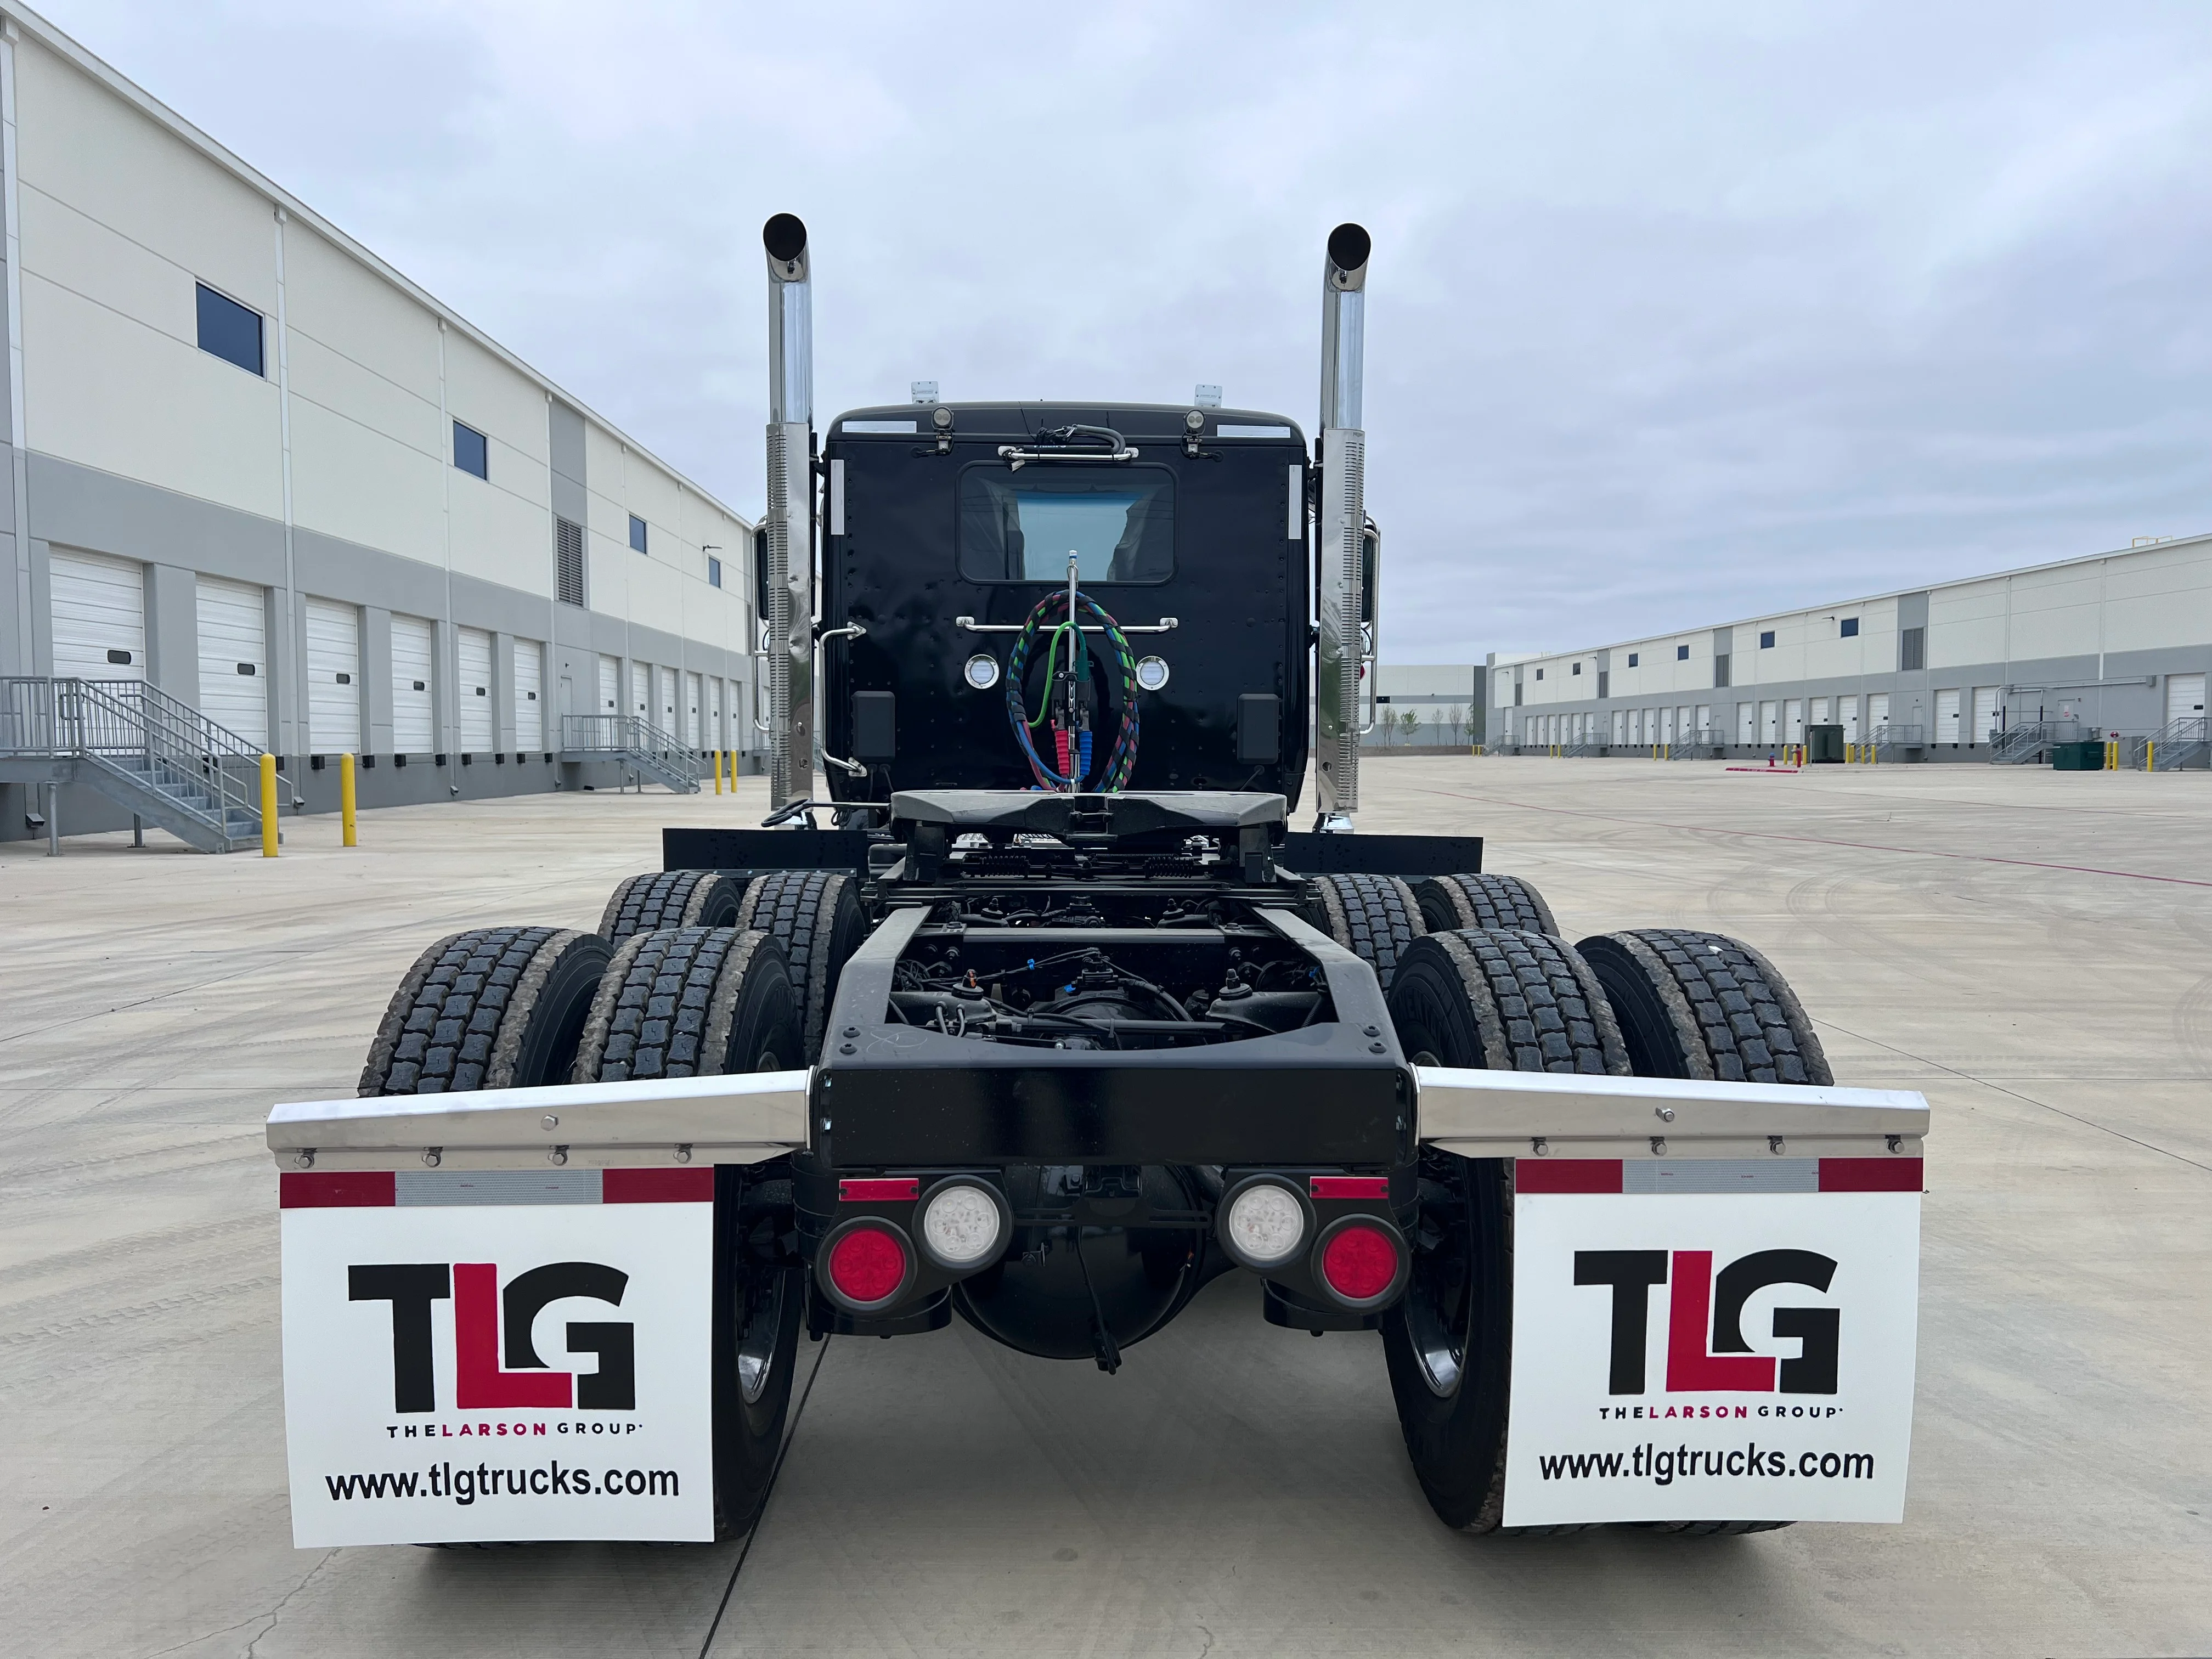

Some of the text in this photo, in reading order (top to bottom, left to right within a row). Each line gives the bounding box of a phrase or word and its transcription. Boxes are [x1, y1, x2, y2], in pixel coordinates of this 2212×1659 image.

[348, 1261, 636, 1413] TLG
[1573, 1249, 1841, 1396] TLG
[557, 1422, 635, 1435] GROUP
[1757, 1406, 1836, 1419] GROUP
[325, 1460, 679, 1505] www.tlgtrucks.com
[1539, 1442, 1874, 1486] www.tlgtrucks.com
